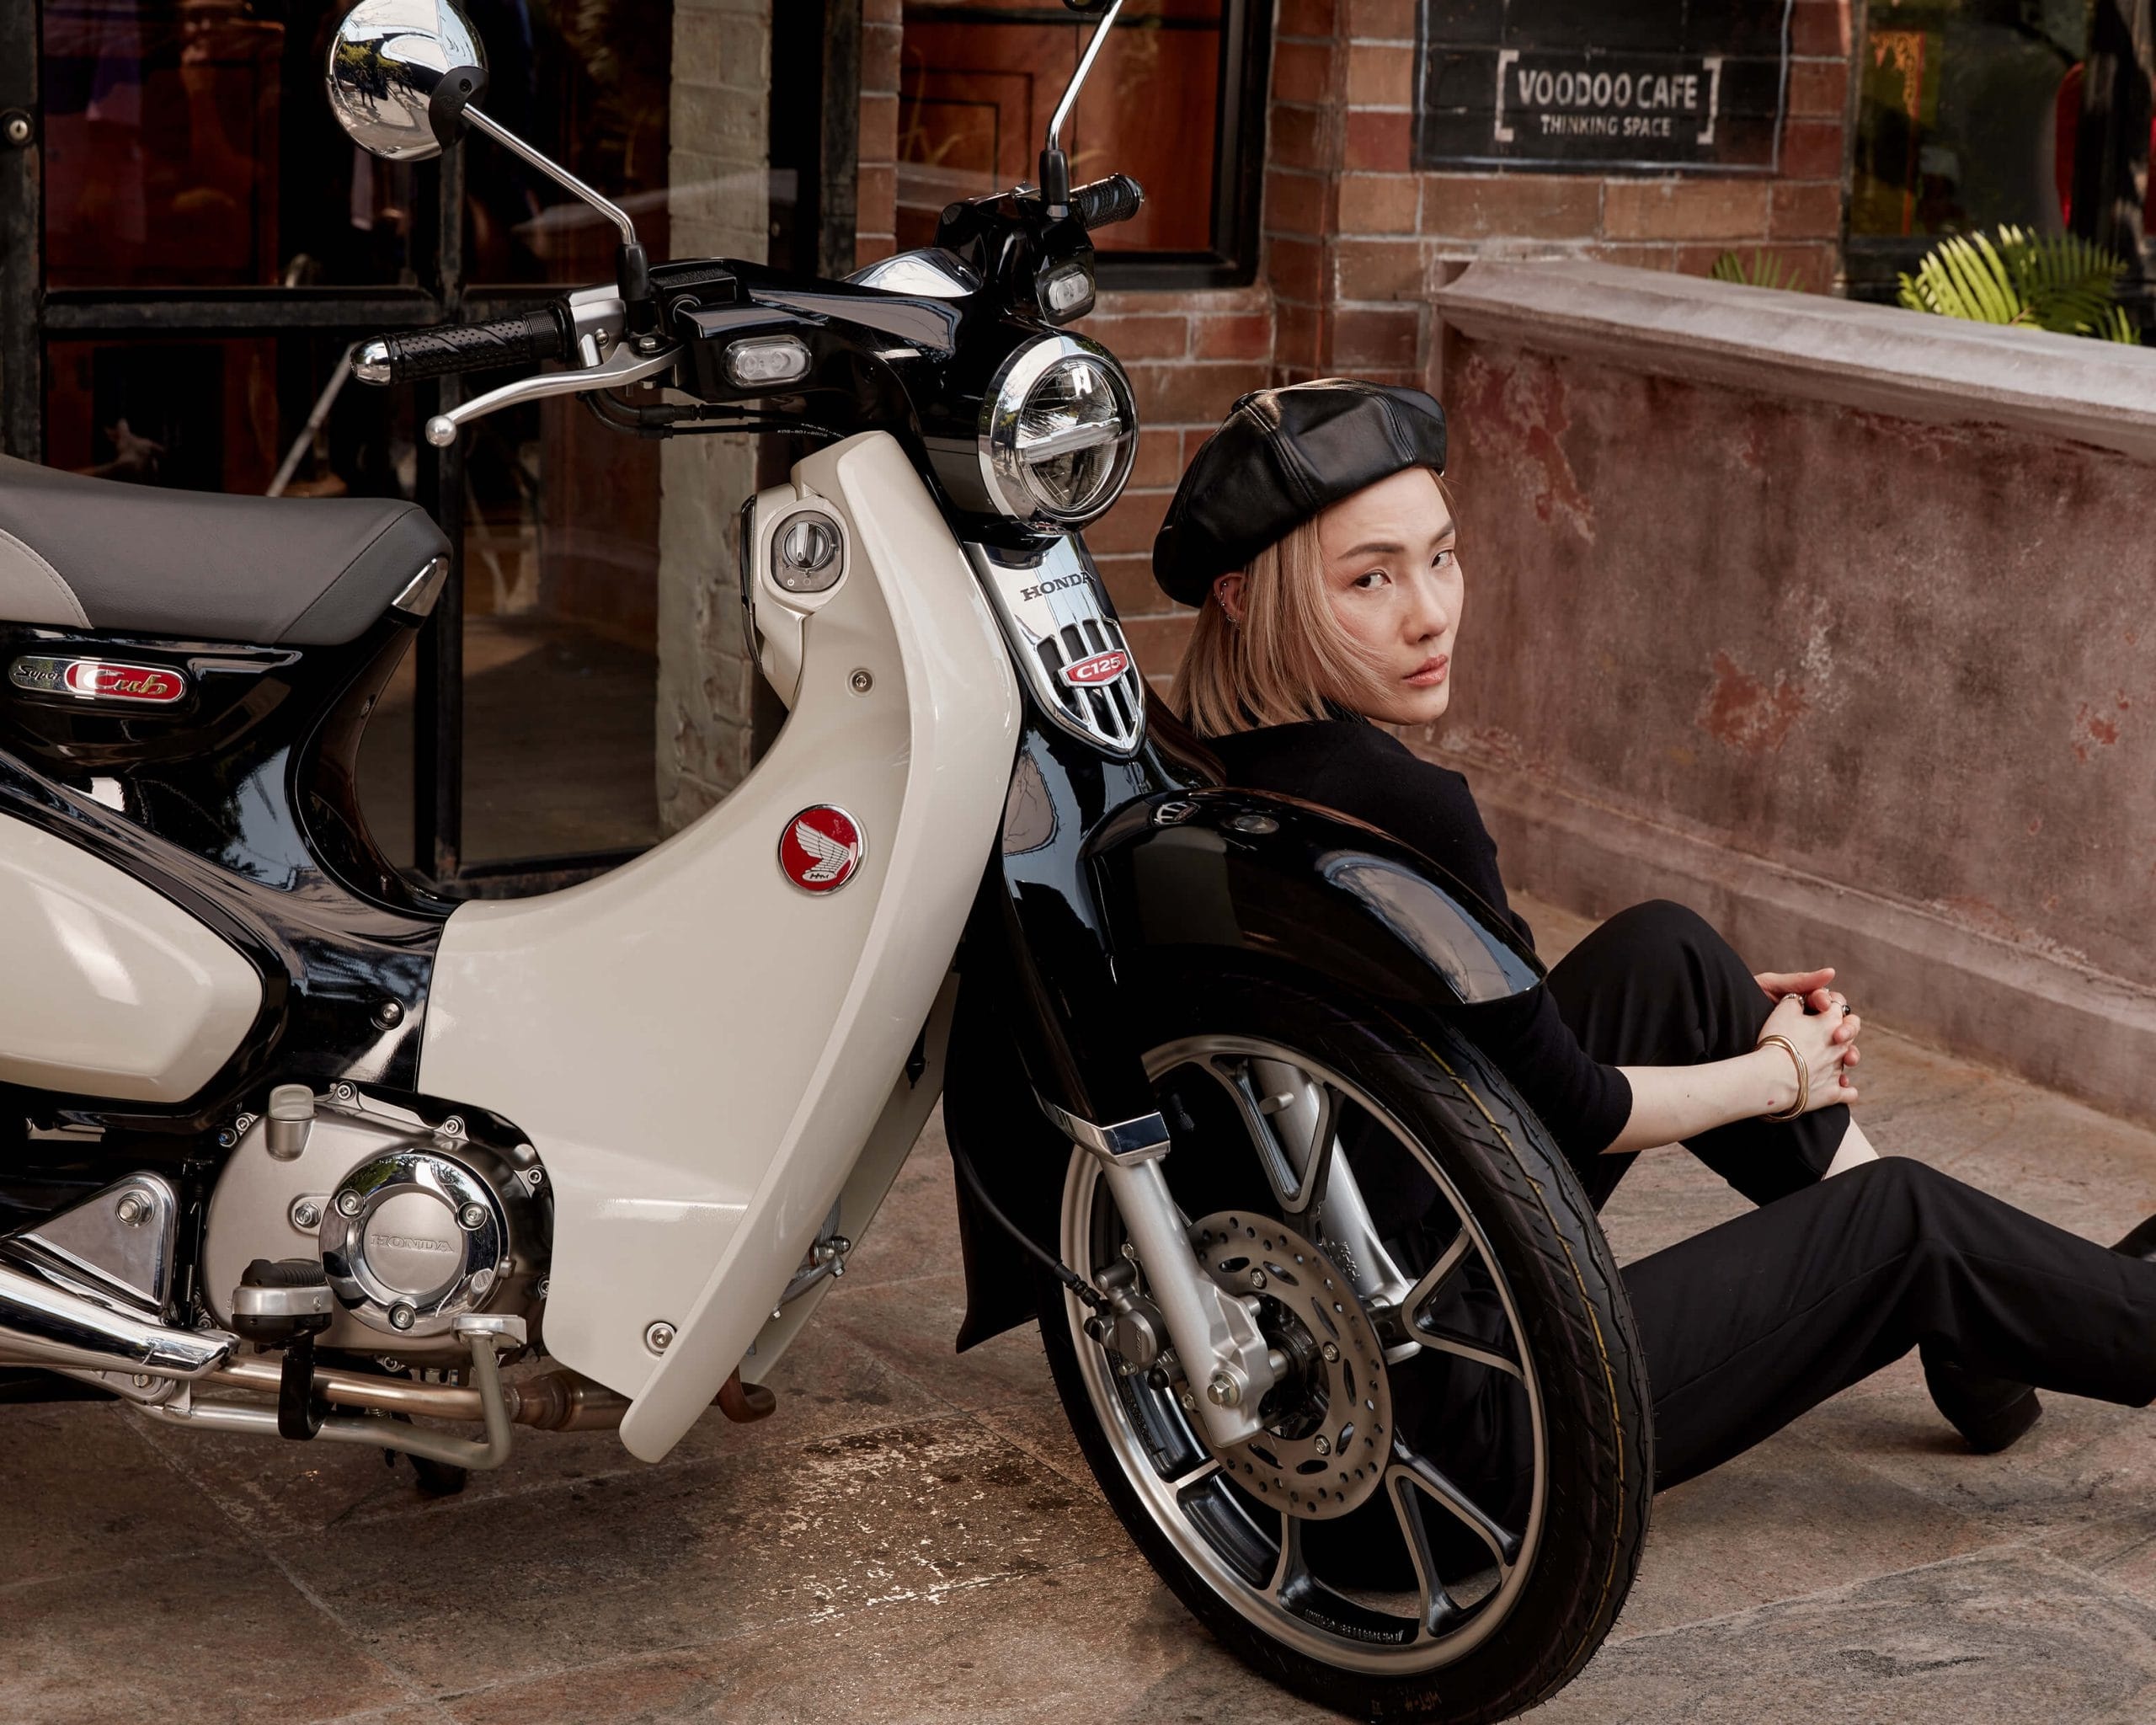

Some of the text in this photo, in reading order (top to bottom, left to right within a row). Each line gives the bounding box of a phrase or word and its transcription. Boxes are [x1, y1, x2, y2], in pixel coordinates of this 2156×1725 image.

[1518, 69, 1698, 109] VOODOO CAFE
[1540, 115, 1672, 137] THINKING SPACE
[1020, 571, 1096, 601] HONDA
[1075, 656, 1121, 680] C125
[83, 668, 168, 696] Cub
[371, 1234, 453, 1252] HONDA
